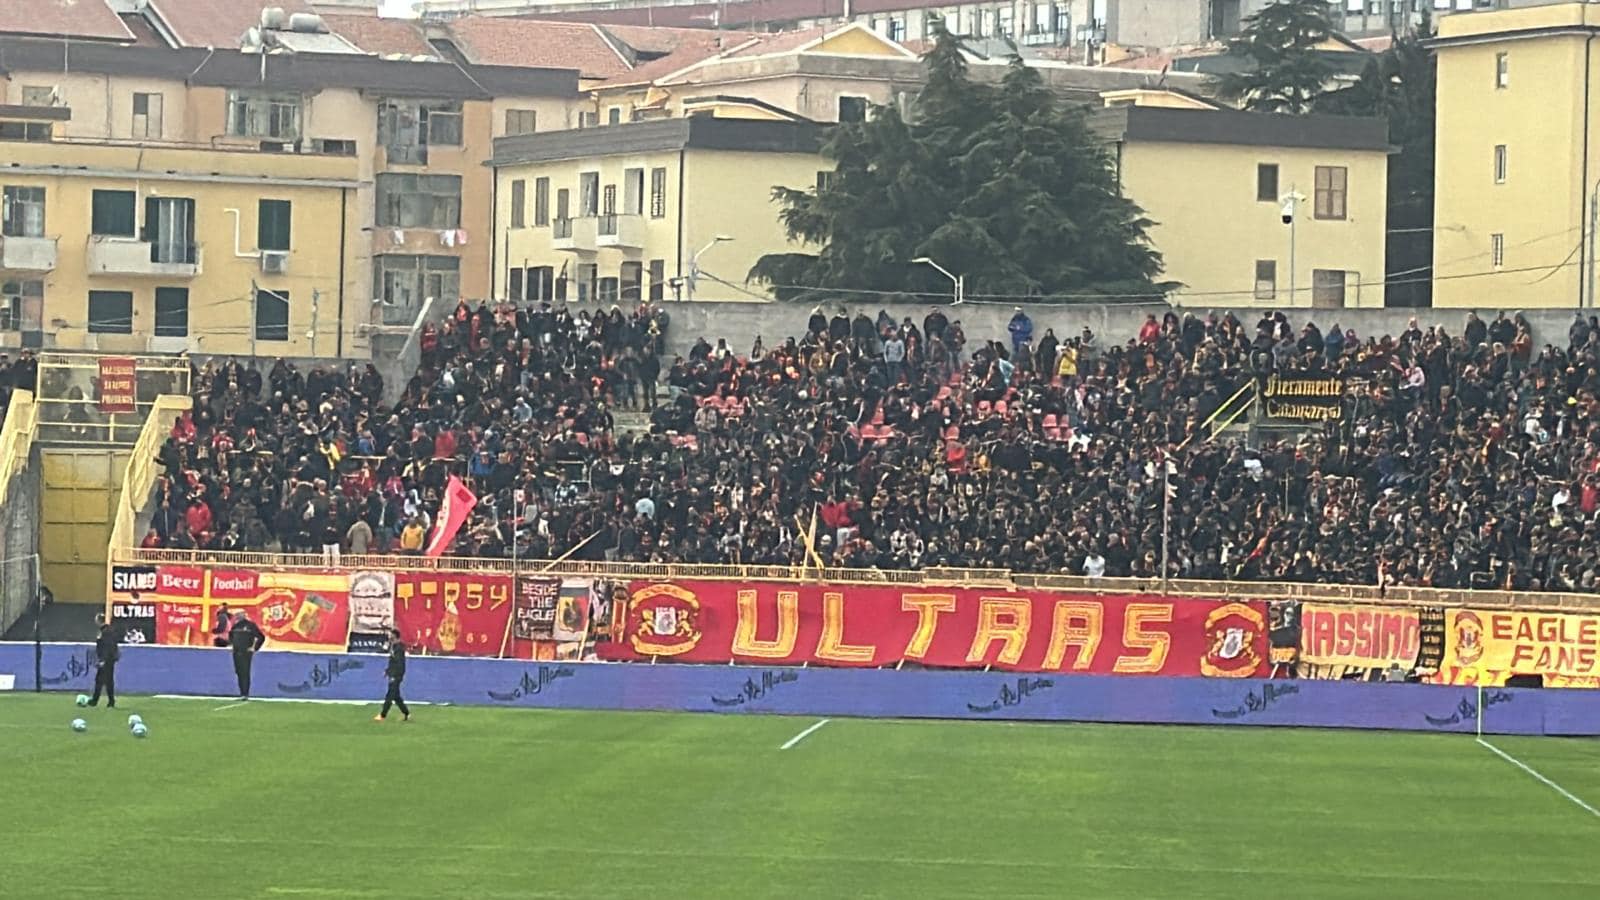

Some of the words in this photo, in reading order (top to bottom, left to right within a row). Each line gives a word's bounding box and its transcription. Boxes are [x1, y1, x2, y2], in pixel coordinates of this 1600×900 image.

[162, 574, 200, 588] Beer
[522, 583, 557, 596] BESIDE
[529, 596, 553, 608] THE
[113, 605, 155, 617] ULTRAS
[731, 589, 1174, 673] ULTRAS
[1511, 645, 1597, 673] FANS
